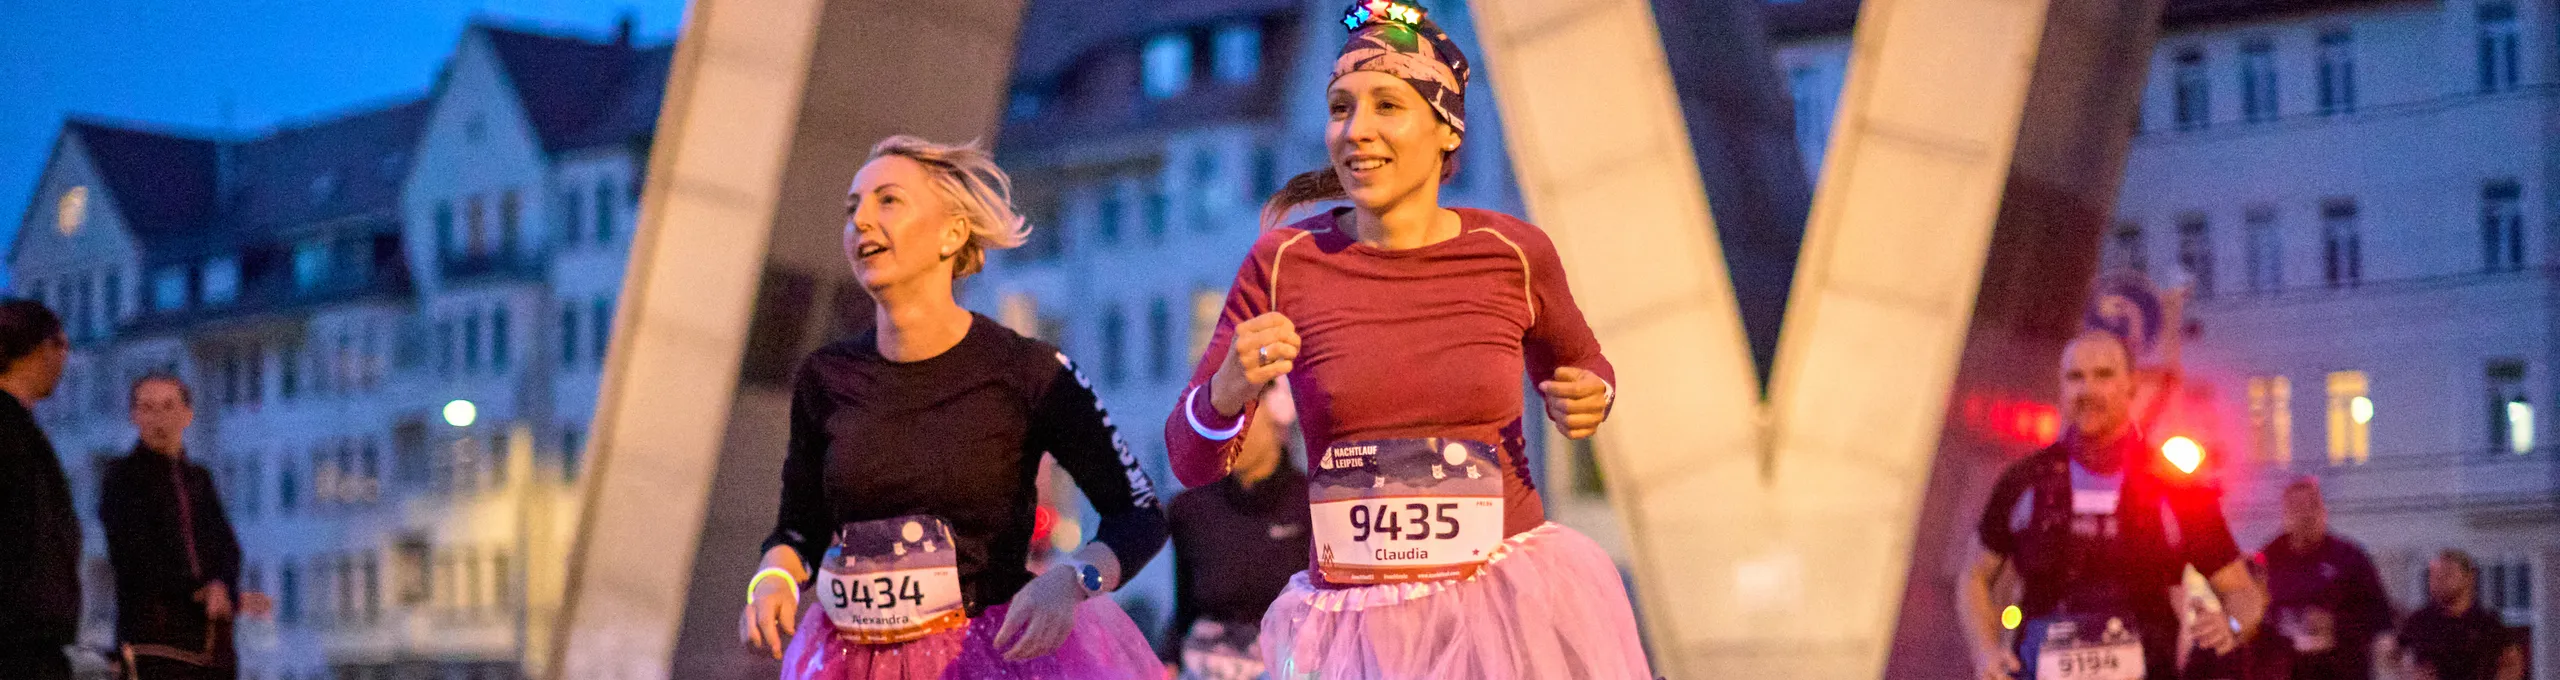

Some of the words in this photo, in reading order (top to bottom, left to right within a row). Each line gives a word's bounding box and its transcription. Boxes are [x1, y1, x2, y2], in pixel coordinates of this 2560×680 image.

[1334, 445, 1377, 457] NACHTLAUF
[1335, 457, 1364, 469] LEIPZIG
[1349, 503, 1460, 542] 9435
[1375, 548, 1428, 561] Claudia
[831, 576, 925, 609] 9434
[852, 614, 909, 625] Alexandra
